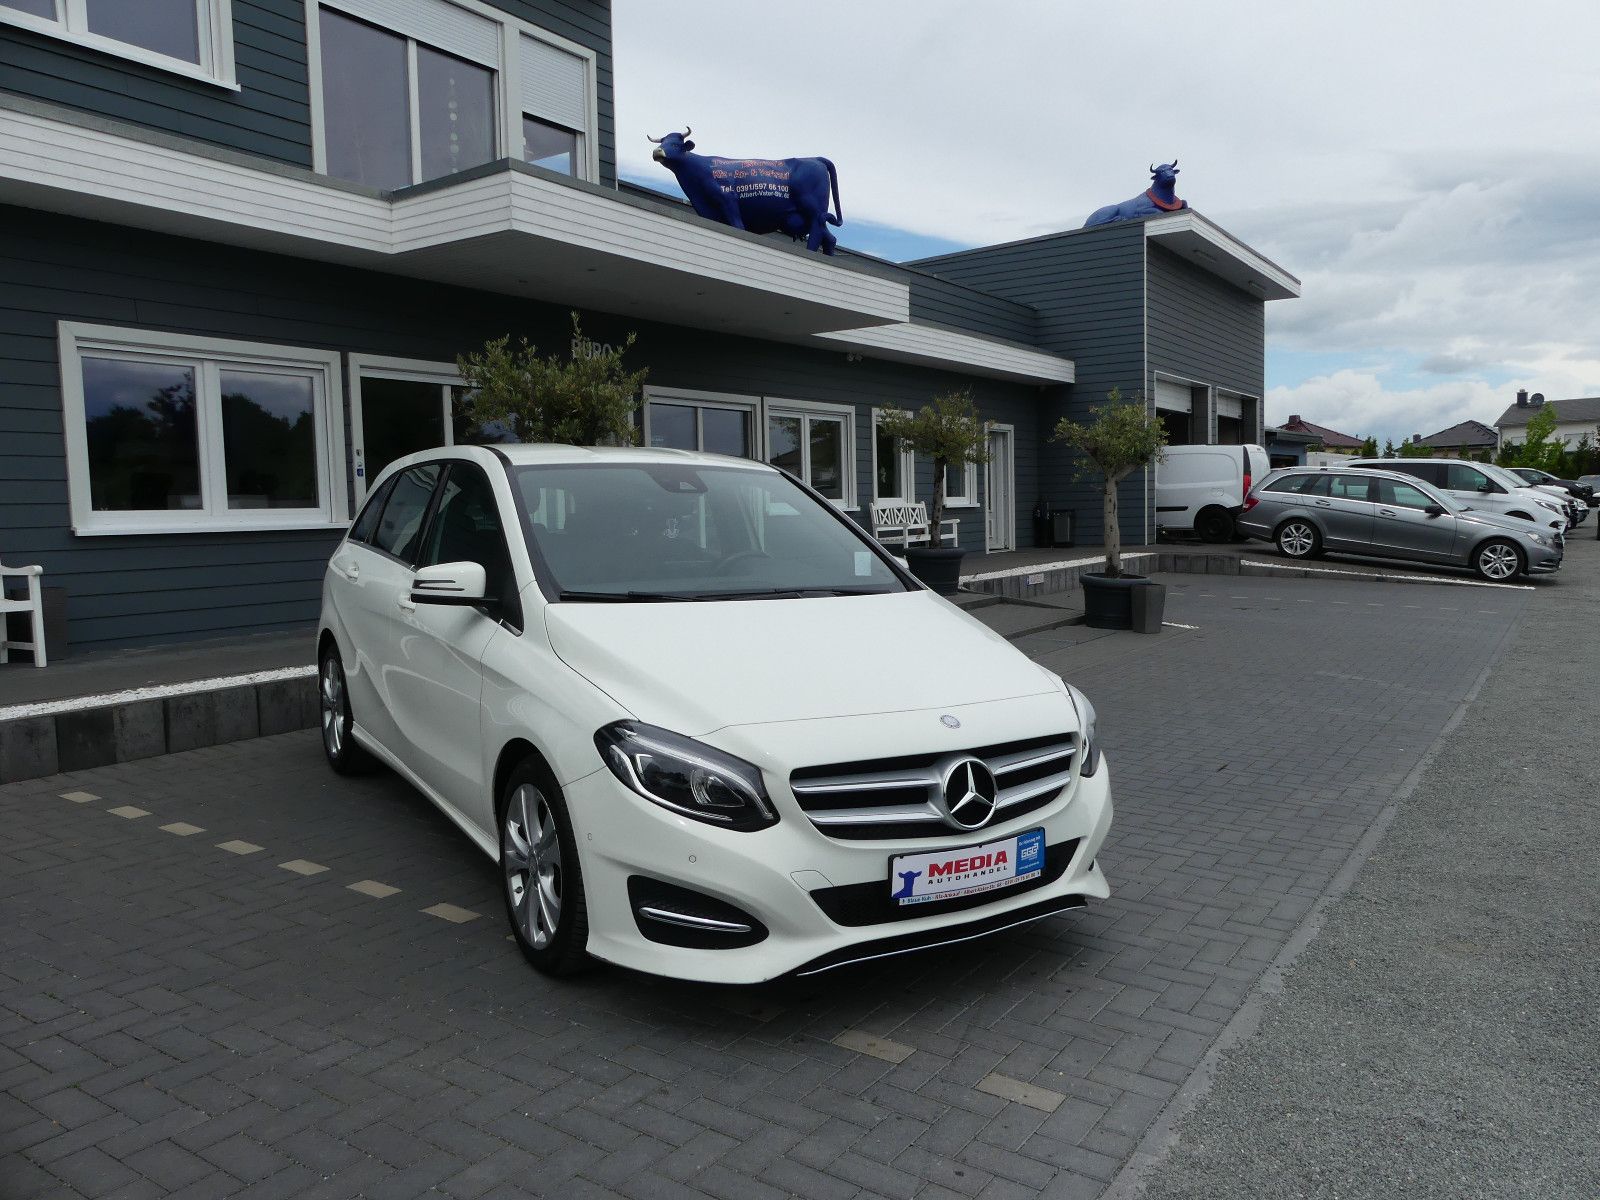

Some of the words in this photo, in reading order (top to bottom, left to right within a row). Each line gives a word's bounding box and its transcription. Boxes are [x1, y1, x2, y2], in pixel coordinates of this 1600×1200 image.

[720, 185, 734, 193] Tel.
[928, 850, 1008, 878] MEDIA
[928, 865, 1008, 885] AUTOHANDEL
